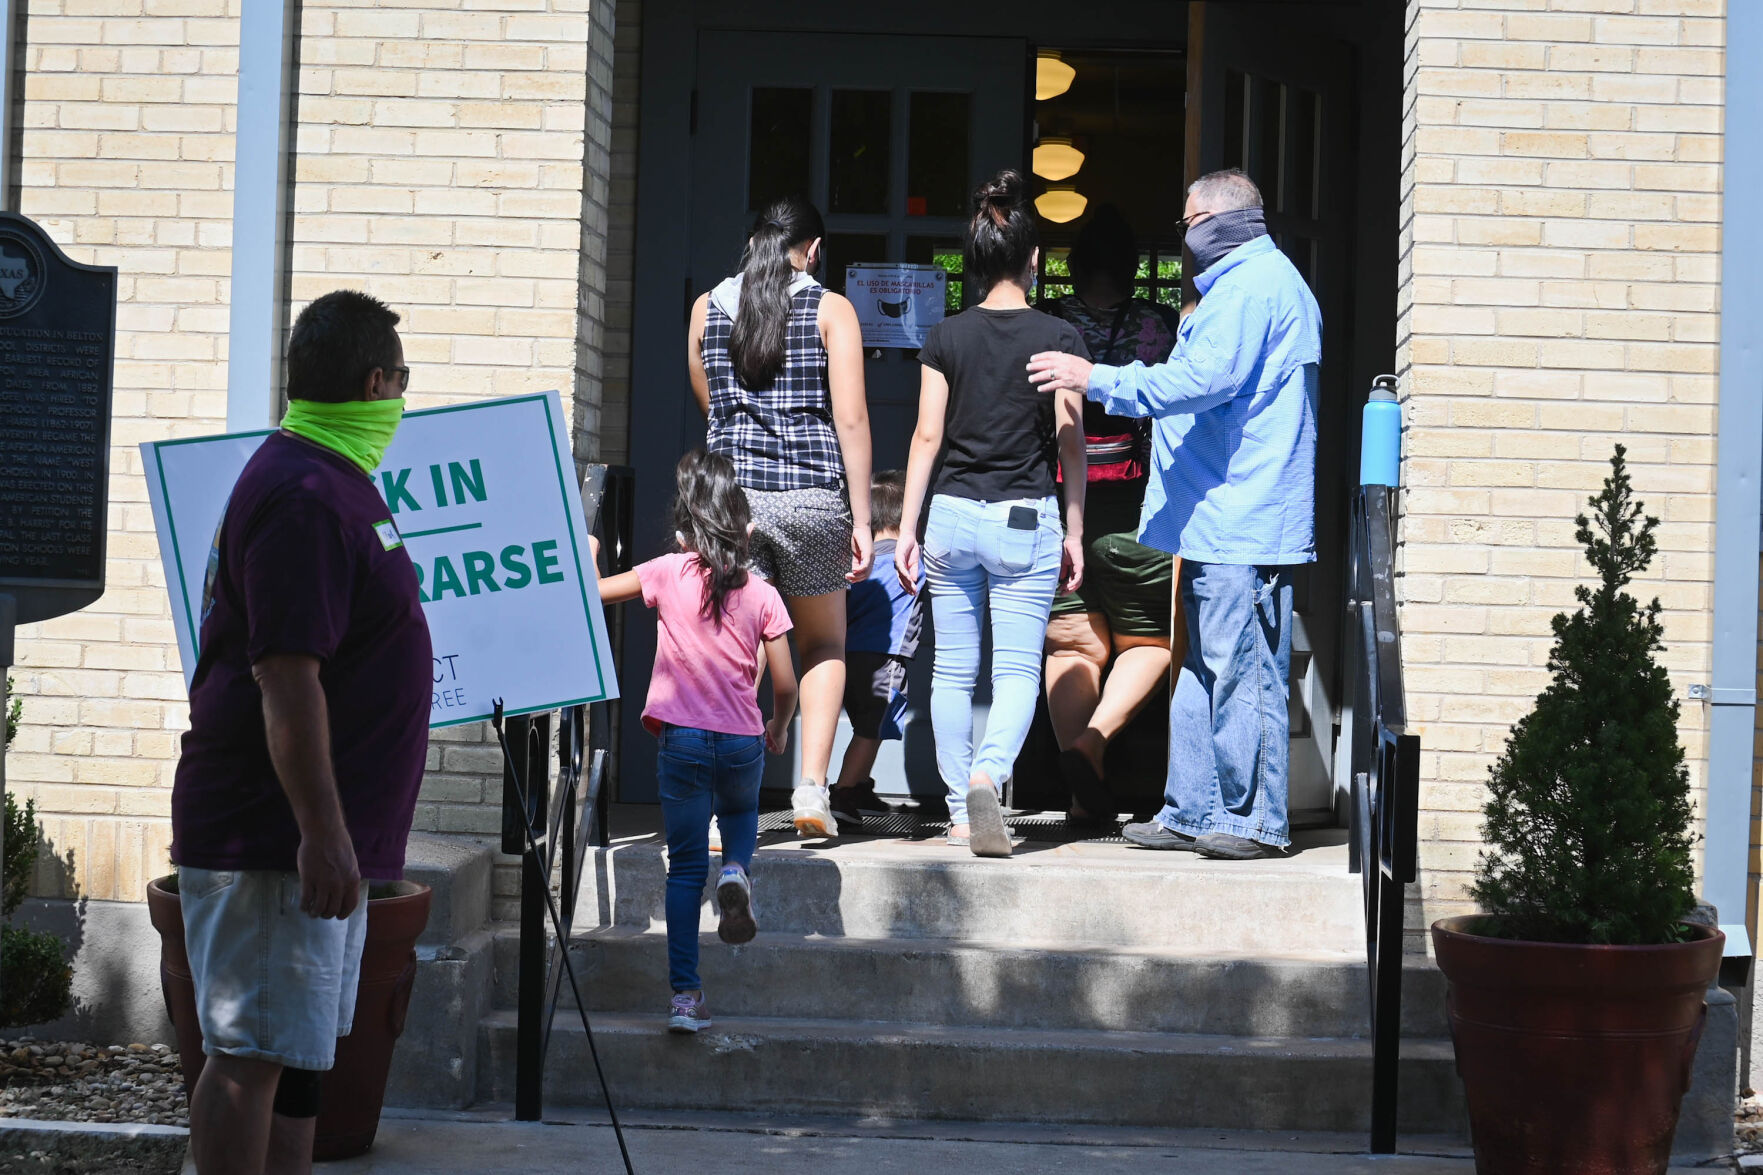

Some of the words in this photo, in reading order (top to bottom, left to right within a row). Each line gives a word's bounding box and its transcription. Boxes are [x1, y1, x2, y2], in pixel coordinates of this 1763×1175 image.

[66, 330, 104, 342] BELTON
[25, 342, 66, 354] DISTRICTS
[75, 344, 99, 356] WERE
[5, 353, 42, 364] EARLIEST
[46, 355, 82, 367] RECORD
[86, 358, 99, 368] OF
[60, 369, 99, 380] AFRICAN
[5, 378, 32, 388] DATES
[40, 380, 68, 391] FROM
[24, 392, 46, 402] WAS
[50, 394, 76, 404] HIRED
[48, 406, 97, 418] PROFESSOR
[6, 416, 39, 428] HARRIS
[41, 431, 79, 442] BECAME
[80, 433, 97, 443] THE
[49, 444, 97, 455] AMERICAN
[34, 455, 64, 466] NAME
[18, 480, 55, 491] ERECTED
[57, 481, 73, 491] ON
[76, 483, 96, 493] THIS
[429, 458, 488, 508] IN
[48, 494, 95, 505] STUDENTS
[31, 506, 70, 517] PETITION
[77, 508, 94, 518] THE
[58, 519, 76, 530] FOR
[20, 531, 37, 541] THE
[40, 532, 61, 542] LAST
[65, 533, 92, 544] CLASS
[22, 543, 64, 554] SCHOOLS
[66, 545, 92, 556] WERE
